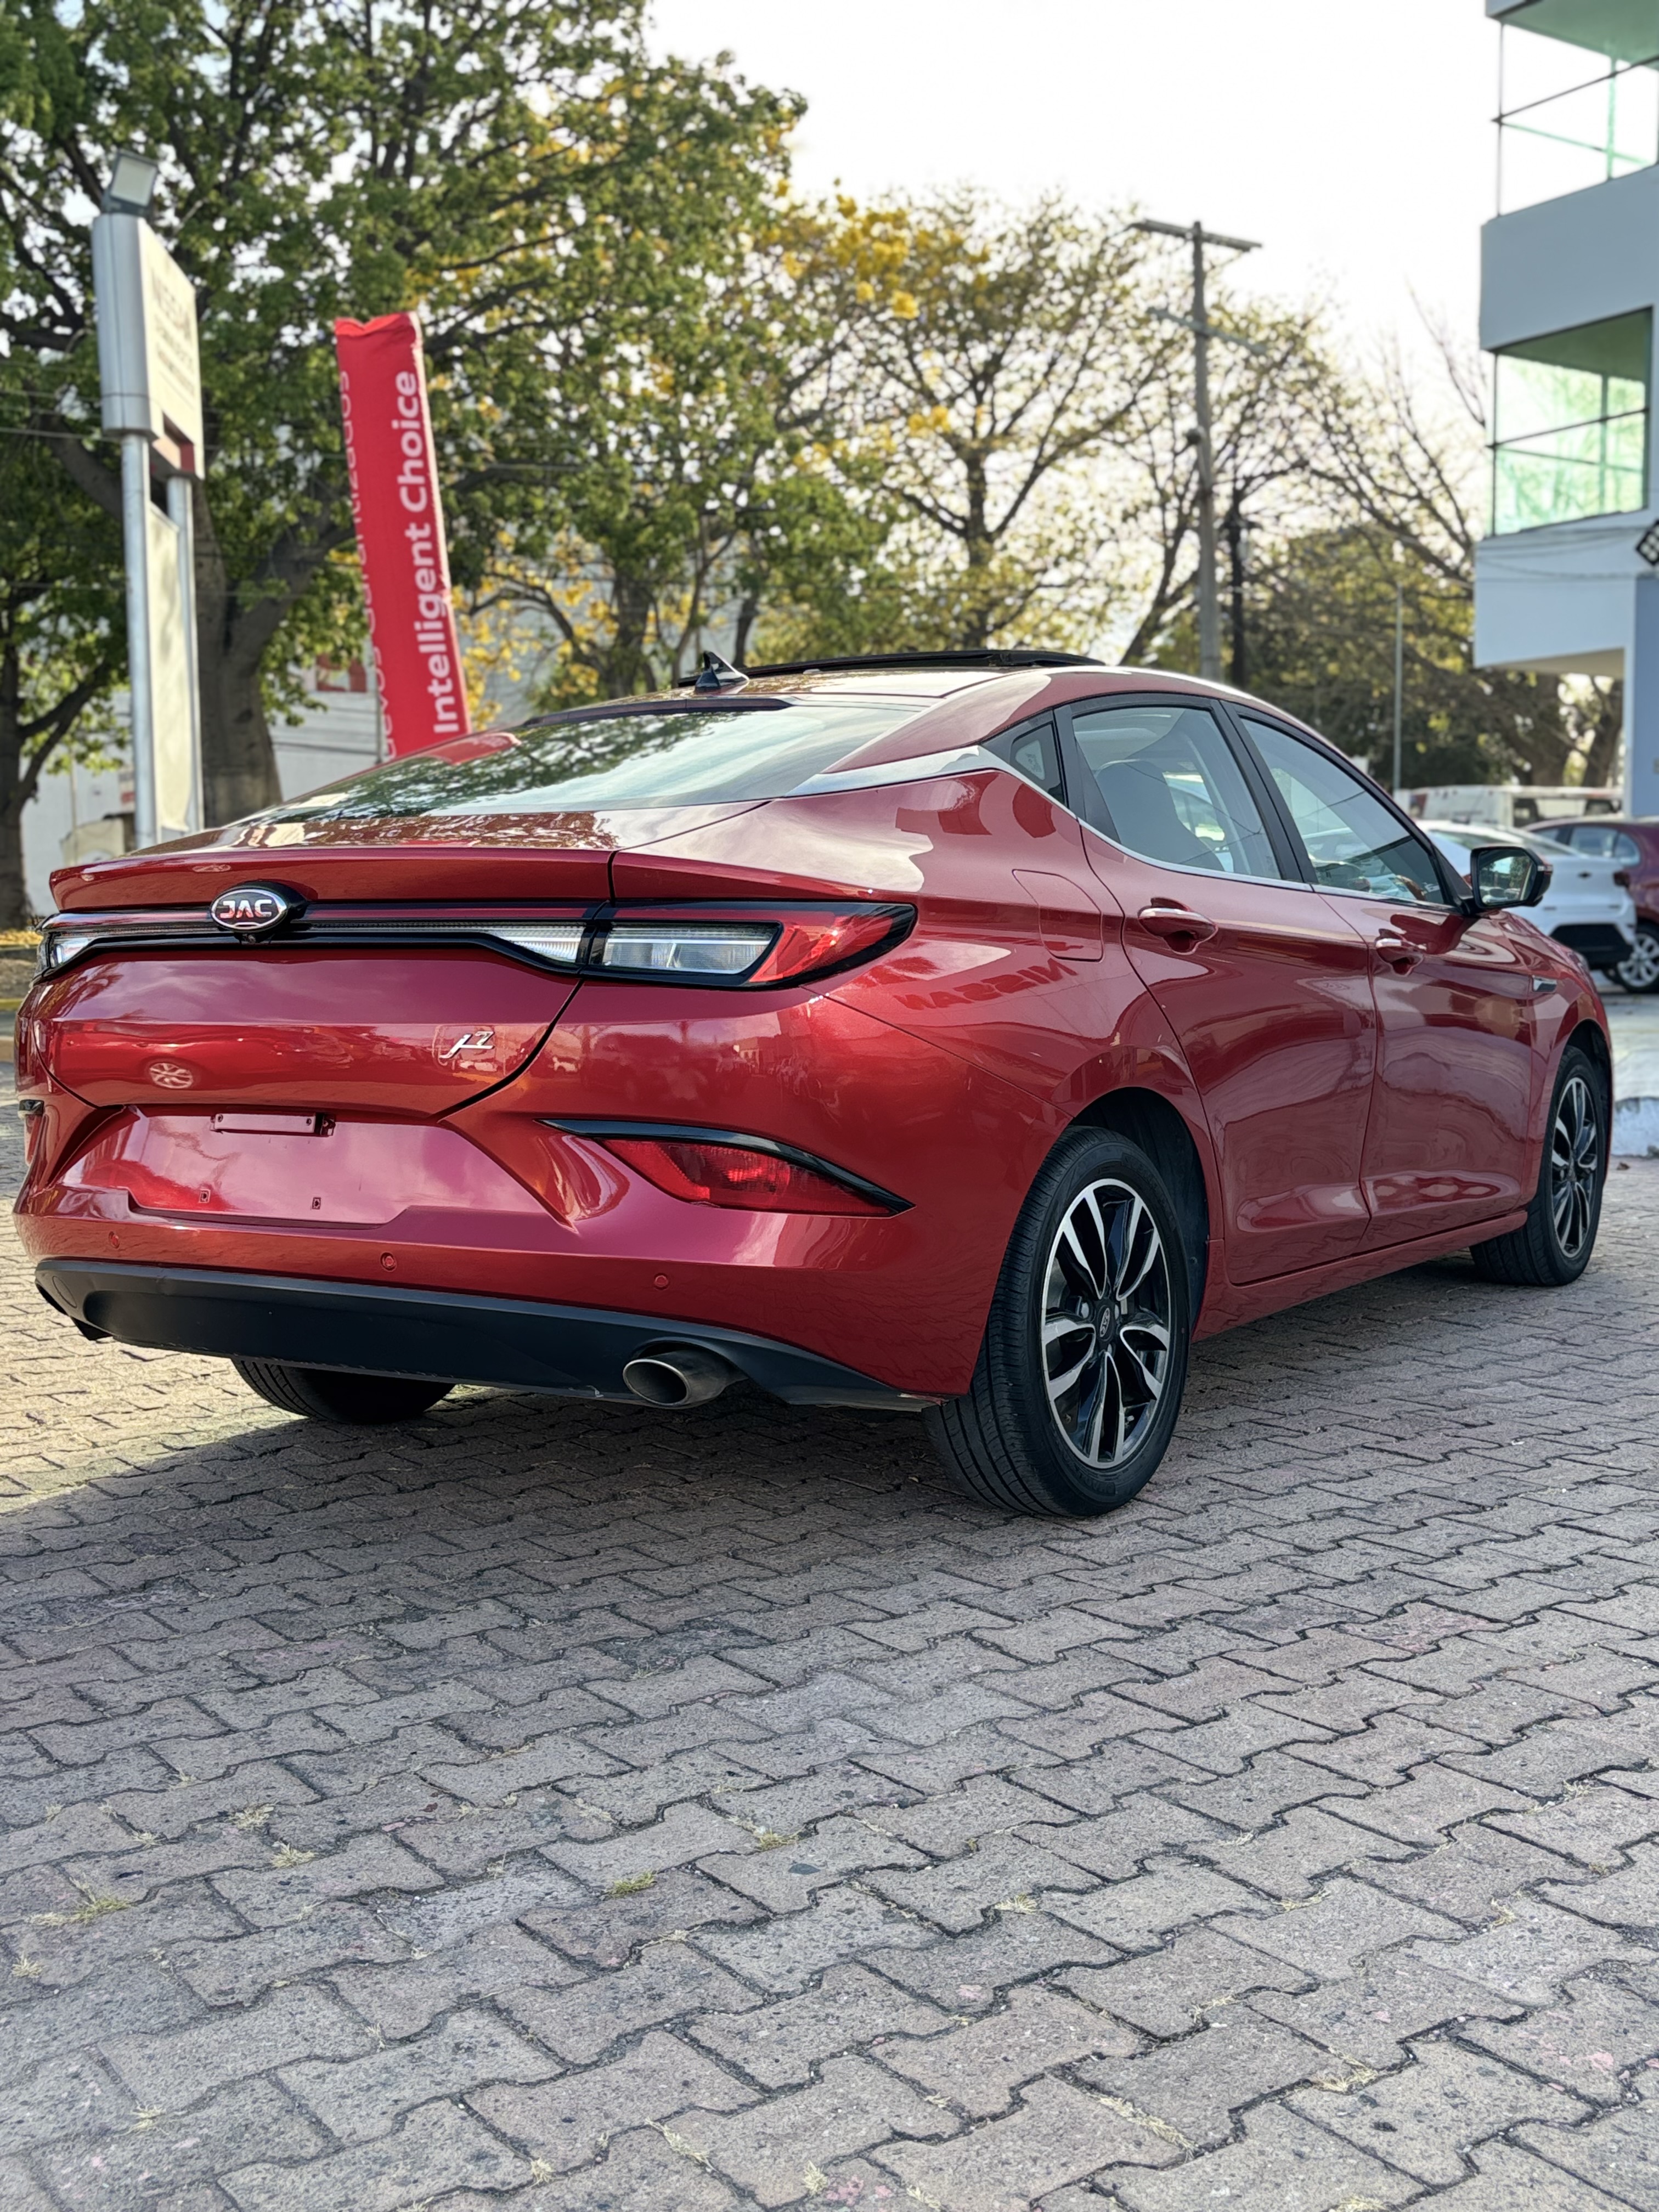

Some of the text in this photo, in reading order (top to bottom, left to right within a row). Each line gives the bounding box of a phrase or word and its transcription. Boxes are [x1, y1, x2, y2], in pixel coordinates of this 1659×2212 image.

[391, 371, 460, 733] Intelligent Choice
[219, 899, 272, 918] JAC
